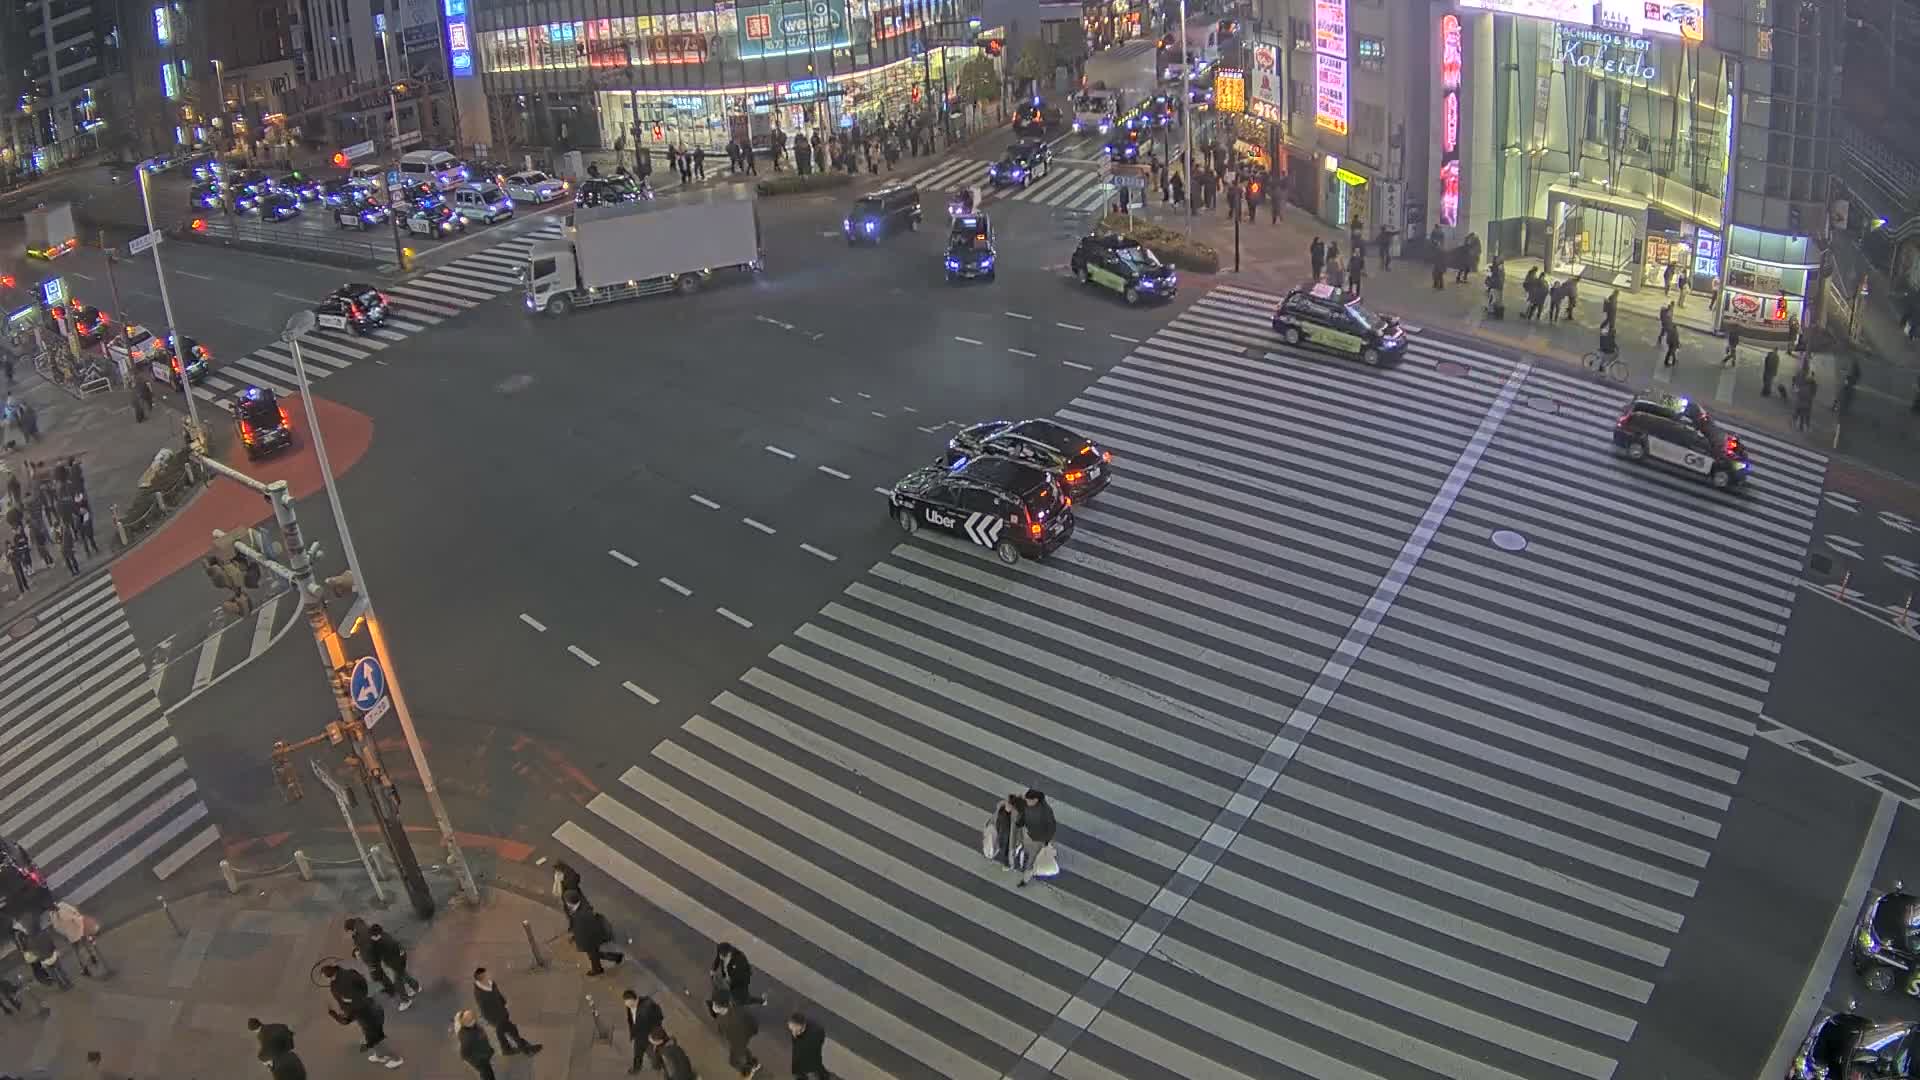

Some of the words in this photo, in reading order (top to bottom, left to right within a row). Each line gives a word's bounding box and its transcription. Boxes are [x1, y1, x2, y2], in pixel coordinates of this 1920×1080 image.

[1556, 22, 1612, 43] PACHINKO
[1614, 34, 1623, 46] &
[1624, 36, 1651, 51] SLOT
[1562, 38, 1656, 80] Kaleido
[925, 508, 956, 529] Uber
